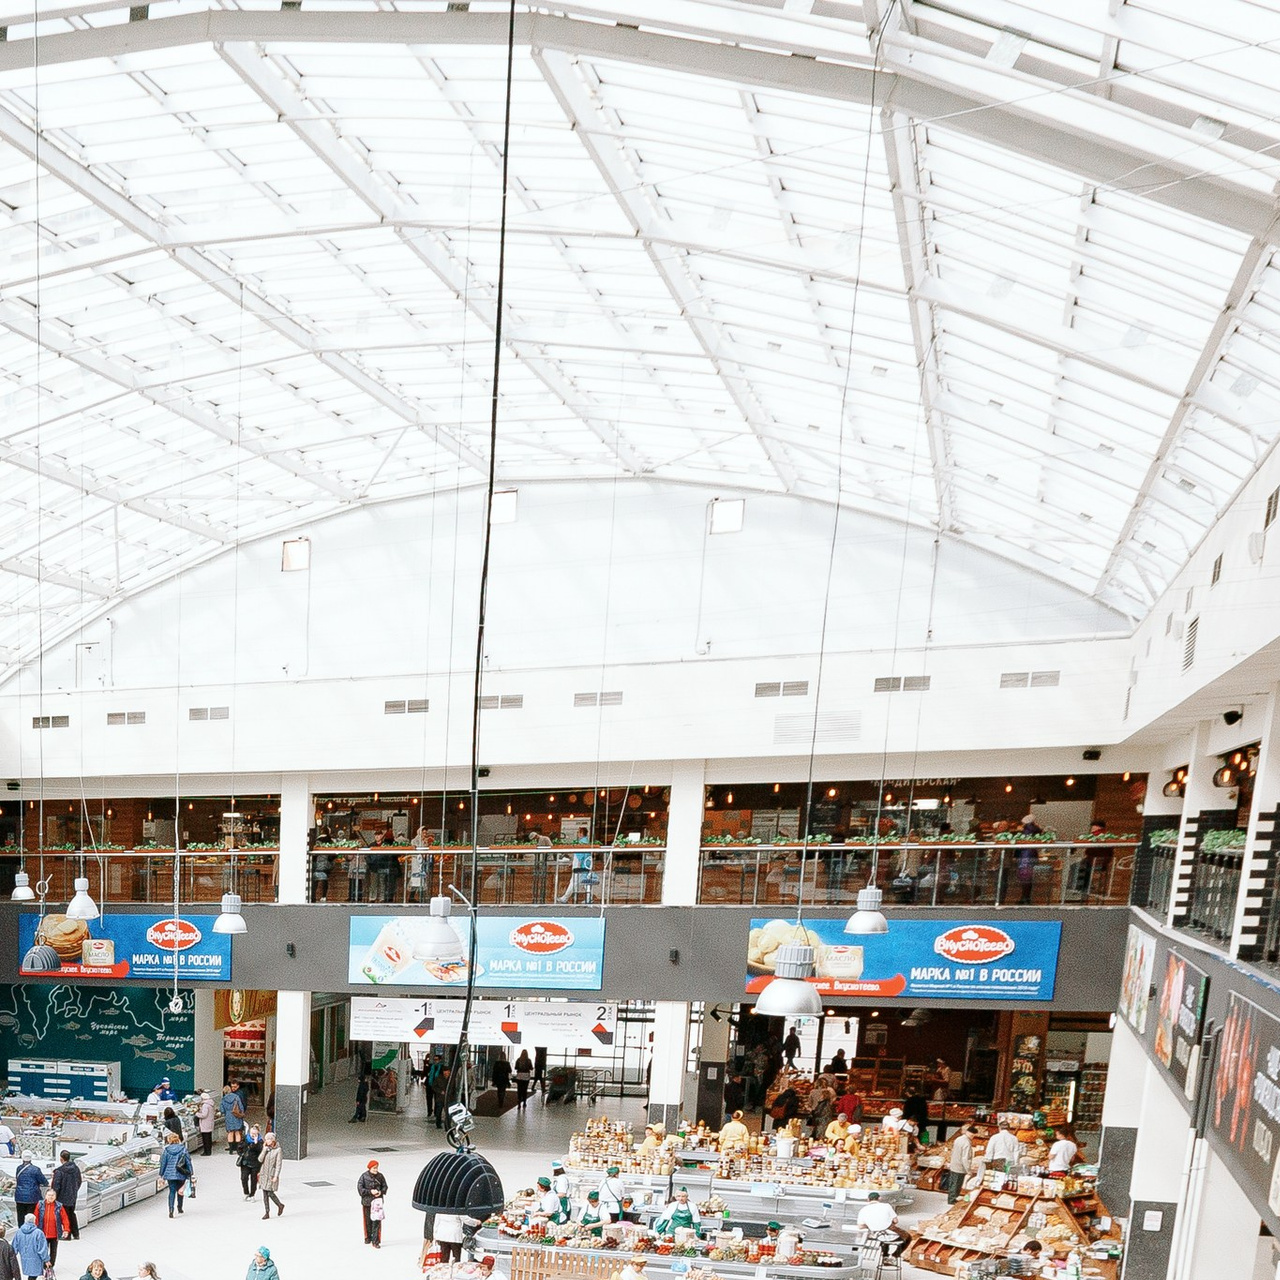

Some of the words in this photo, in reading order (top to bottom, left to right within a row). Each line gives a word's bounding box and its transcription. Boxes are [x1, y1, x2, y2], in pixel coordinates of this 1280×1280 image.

[132, 953, 160, 965] МАРКА
[179, 955, 186, 965] В
[187, 955, 222, 966] РОССИИ
[489, 959, 522, 971] МАРКА
[526, 960, 542, 972] №1
[545, 960, 553, 972] В
[556, 961, 597, 973] РОССИИ
[910, 967, 951, 980] МАРКА
[954, 968, 975, 980] №1
[979, 968, 988, 981] В
[991, 969, 1042, 983] РОССИИ
[414, 1002, 428, 1016] -1
[503, 1004, 511, 1018] 1
[596, 1006, 607, 1020] 2
